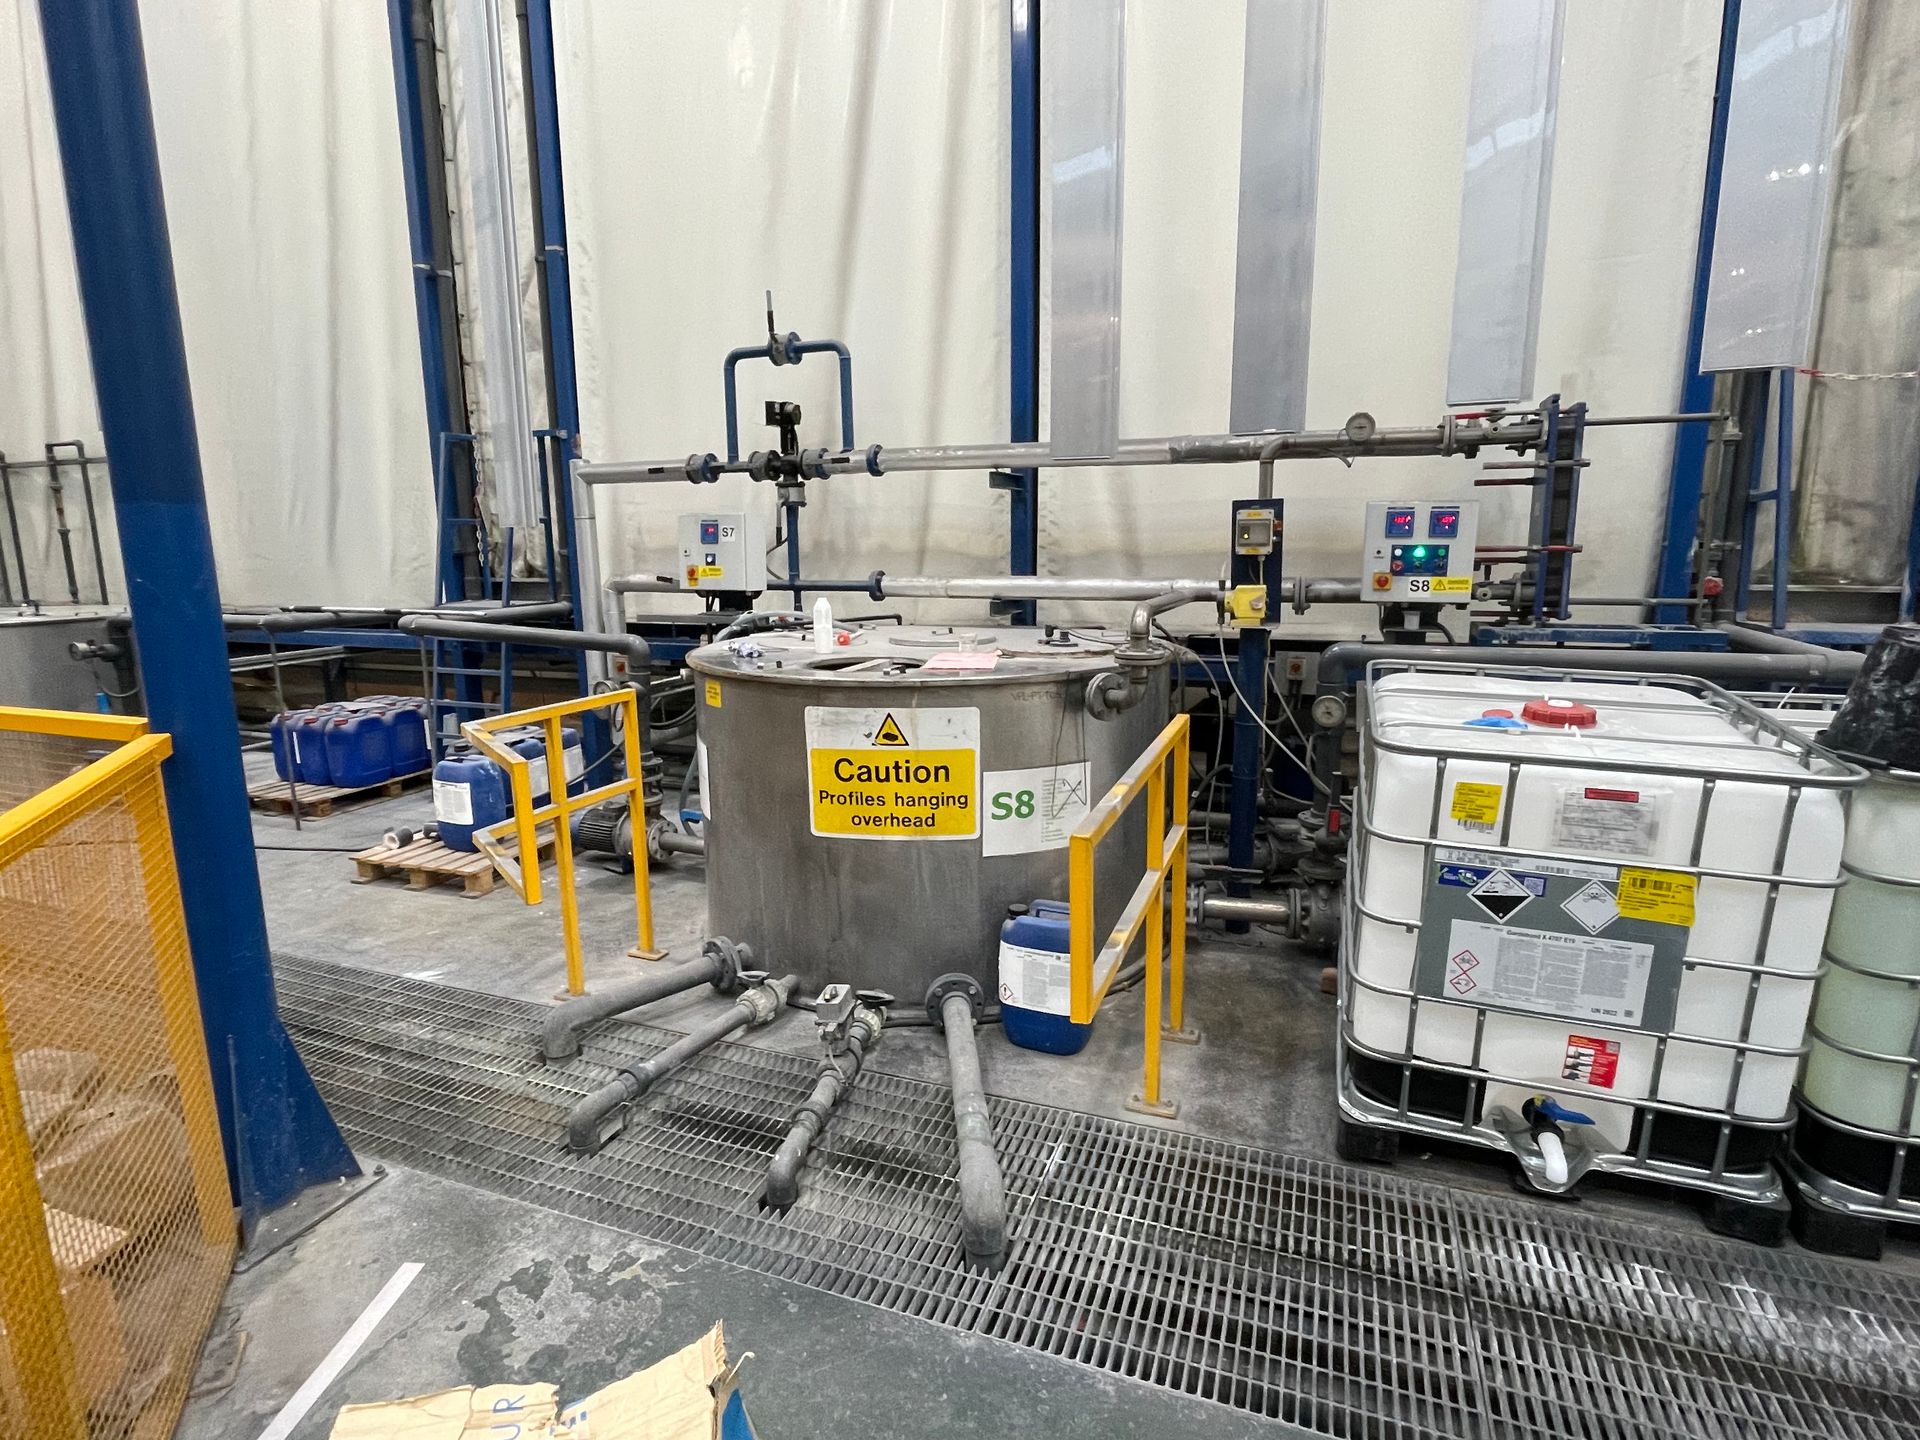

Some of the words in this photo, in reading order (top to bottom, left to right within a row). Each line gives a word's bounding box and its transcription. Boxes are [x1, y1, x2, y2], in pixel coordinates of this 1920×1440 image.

[722, 527, 735, 537] S7
[1409, 579, 1430, 592] S8
[833, 757, 950, 783] Caution
[819, 790, 886, 807] Profiles
[894, 790, 969, 810] hanging
[991, 790, 1035, 821] S8
[851, 812, 936, 828] overhead
